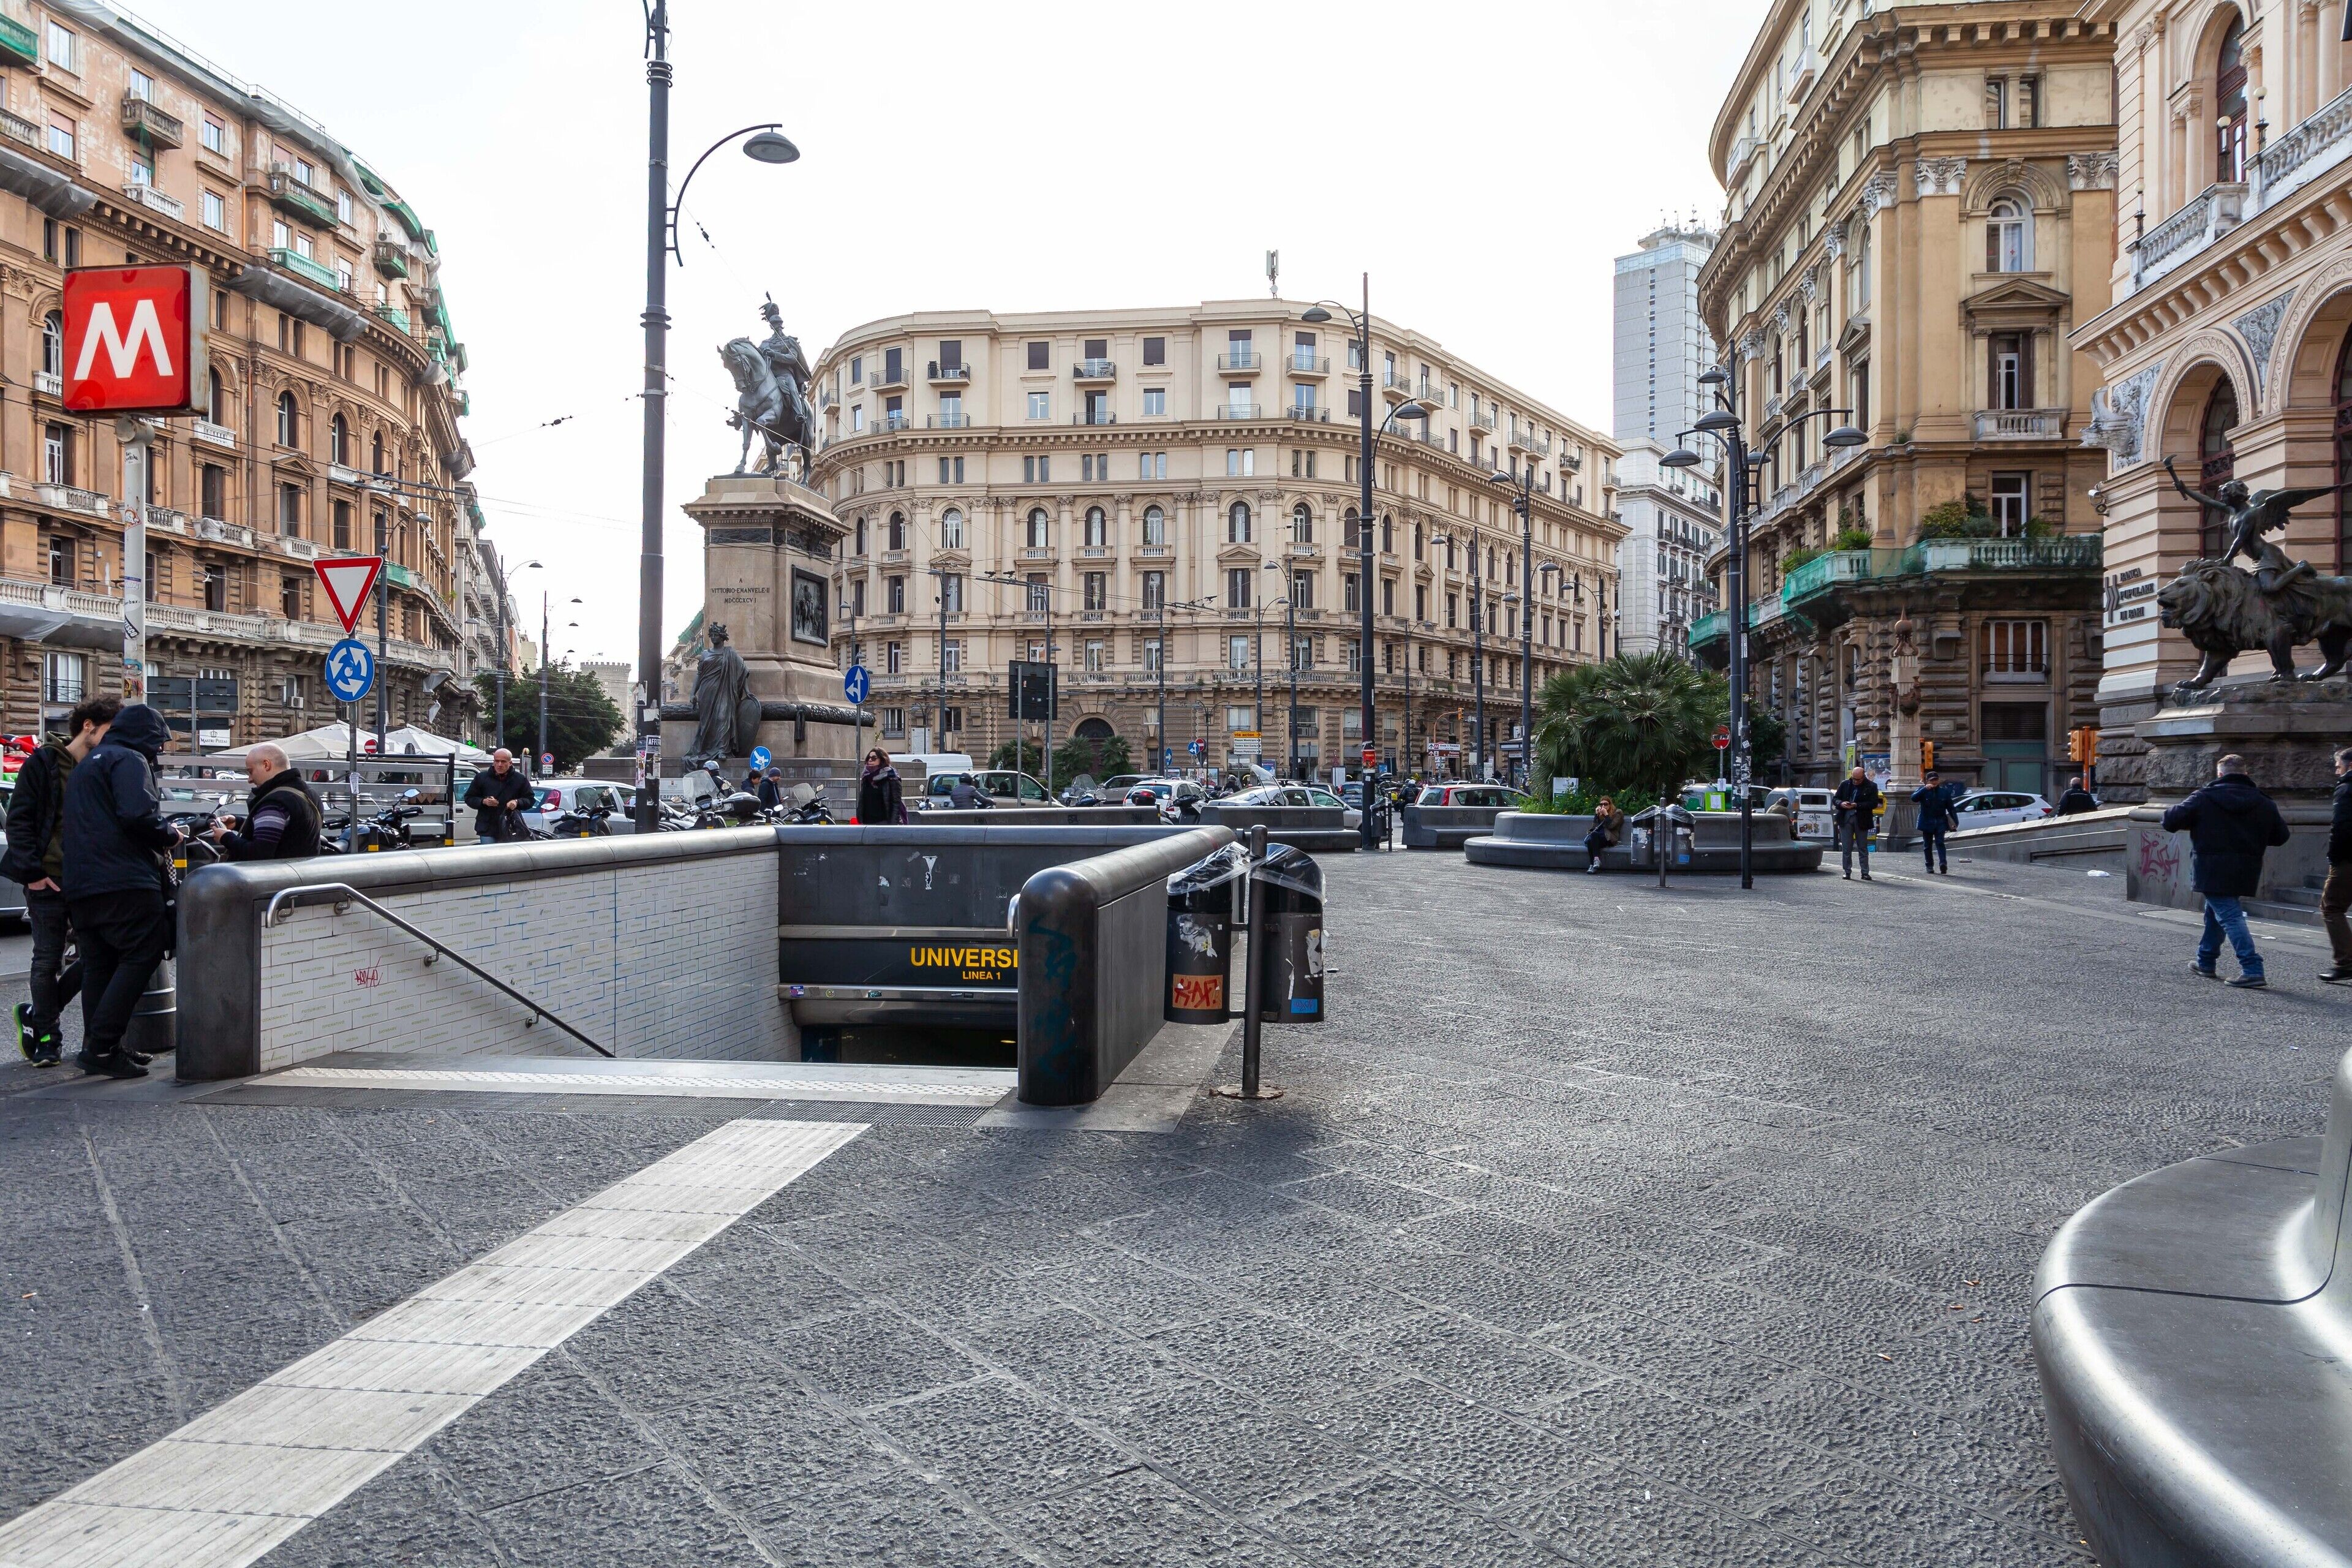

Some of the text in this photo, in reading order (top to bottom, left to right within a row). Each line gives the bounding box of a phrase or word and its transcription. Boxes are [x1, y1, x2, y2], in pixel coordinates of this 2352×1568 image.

[74, 299, 174, 380] M
[2120, 567, 2142, 581] BANCA
[2120, 606, 2144, 620] DI BARI
[963, 971, 993, 979] LINEA
